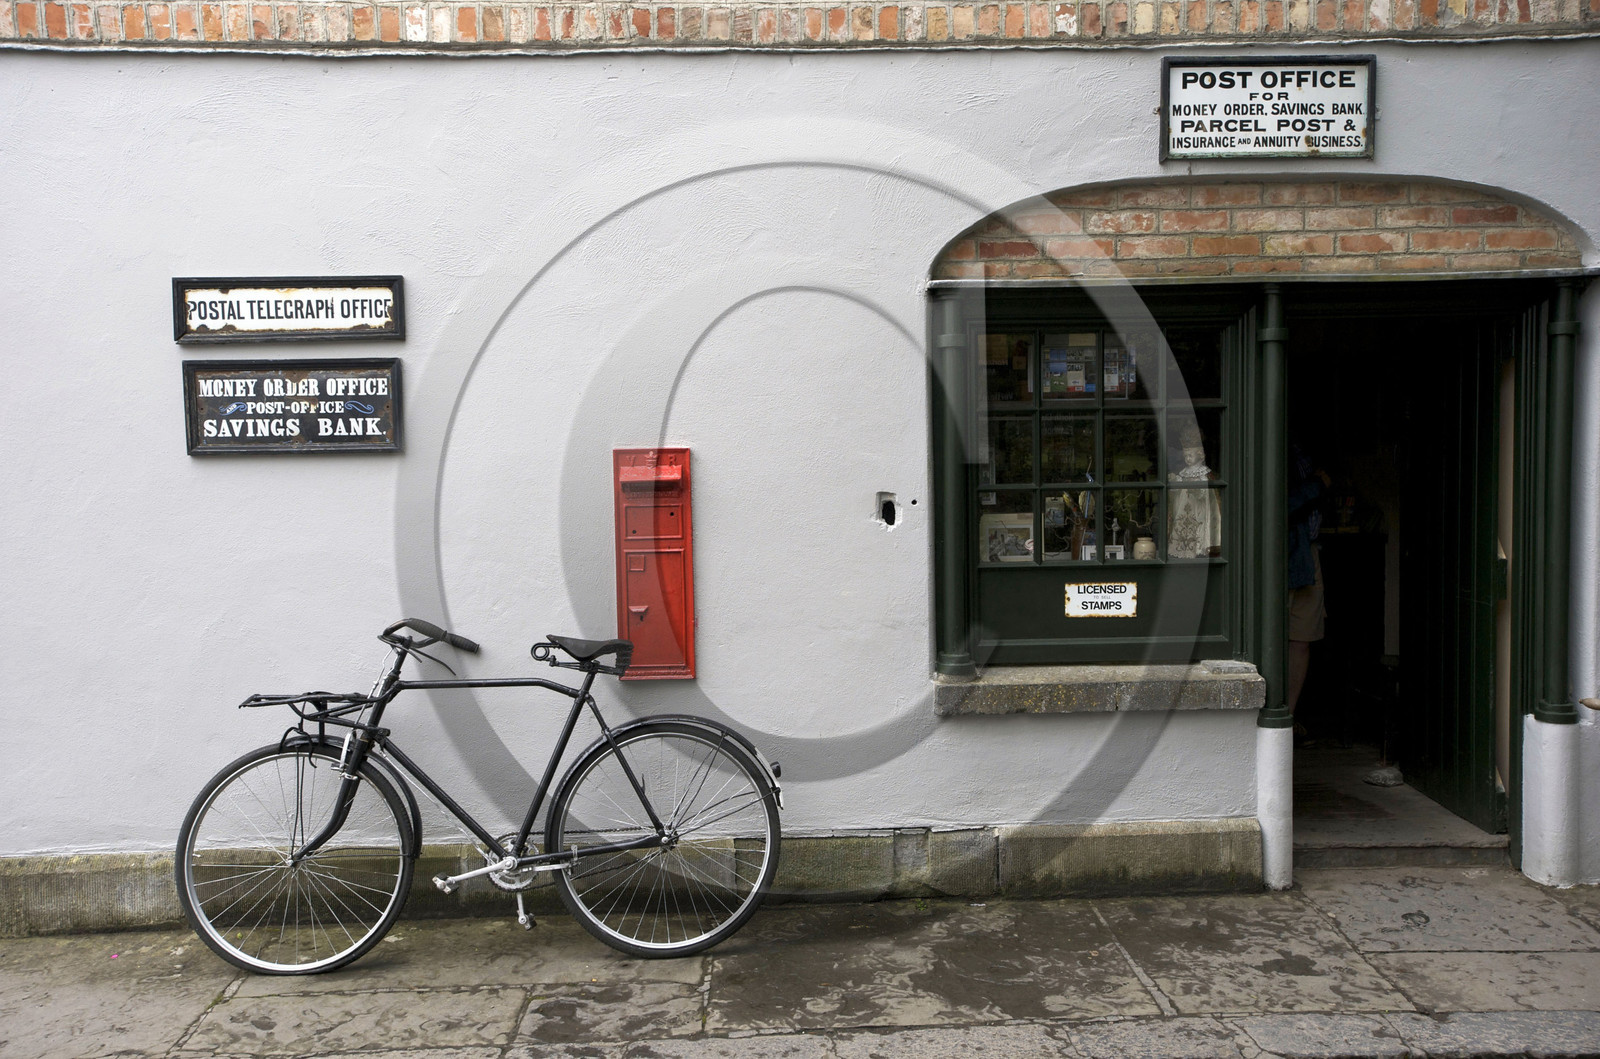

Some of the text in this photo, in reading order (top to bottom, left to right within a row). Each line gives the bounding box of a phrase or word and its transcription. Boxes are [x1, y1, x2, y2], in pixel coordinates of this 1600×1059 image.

[1182, 70, 1356, 89] POST OFFICE
[1249, 92, 1290, 101] FOR
[1172, 103, 1218, 117] MONEY
[1271, 103, 1325, 116] SAVINGS
[1180, 119, 1356, 133] PARCEL POST &
[1172, 136, 1236, 149] INSURANCE
[1237, 137, 1252, 145] AND
[1253, 135, 1301, 148] ANNUITY
[188, 298, 392, 321] POSTAL TELEGRAPH OFFICE
[198, 377, 388, 397] MONEY ORDER OFFICE
[203, 417, 387, 438] SAVINGS BANK.
[1077, 584, 1127, 594] LICENSED
[1081, 600, 1122, 610] STAMPS
